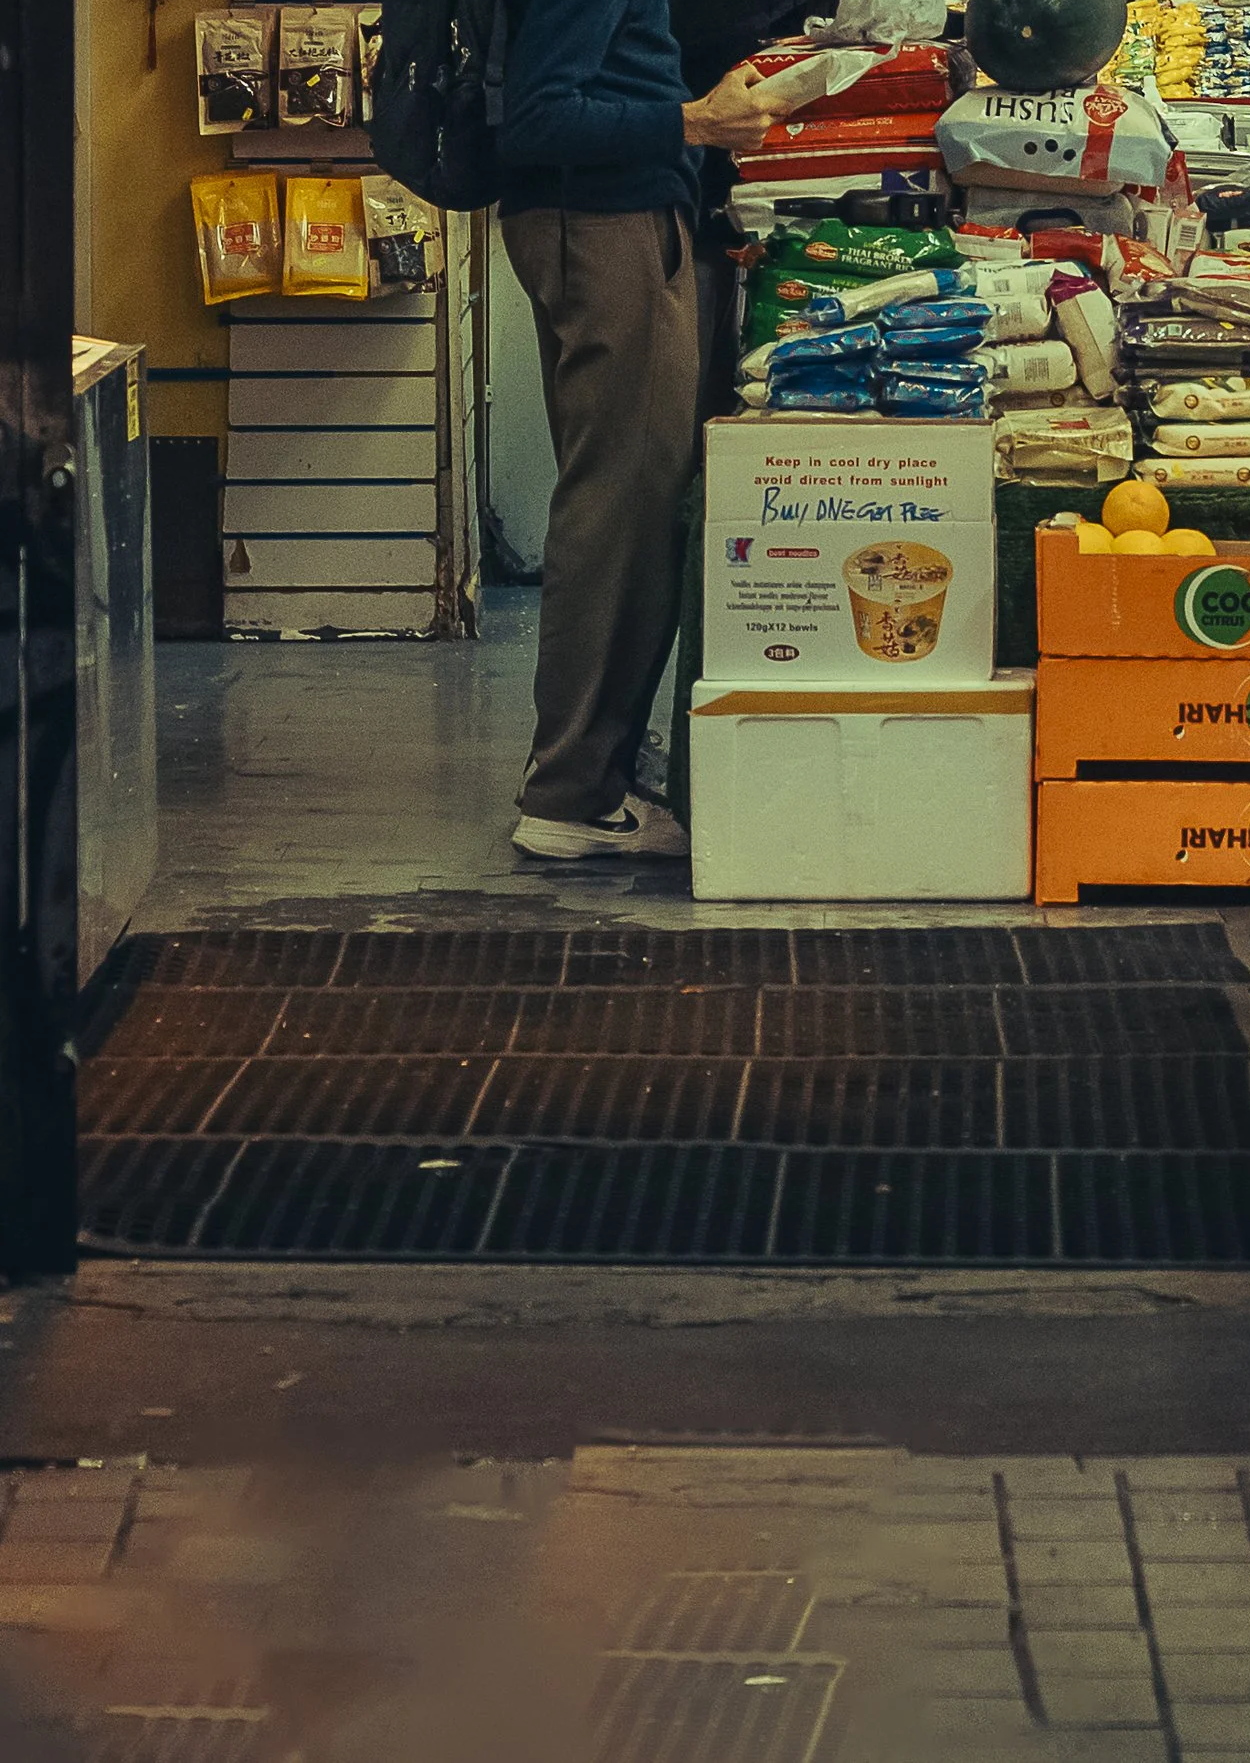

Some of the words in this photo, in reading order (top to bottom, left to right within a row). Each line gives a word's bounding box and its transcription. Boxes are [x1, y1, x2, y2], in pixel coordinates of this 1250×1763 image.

[984, 95, 1075, 124] SUSHI
[841, 255, 892, 269] FRAGRANT
[765, 456, 801, 469] Keep
[808, 456, 822, 468] in
[829, 456, 860, 468] cool
[867, 456, 891, 469] dry
[898, 457, 938, 469] place
[753, 474, 792, 485] avoid
[799, 474, 842, 486] direct
[850, 474, 883, 486] from
[889, 475, 949, 489] sunlight
[746, 622, 786, 633] 120gX12
[788, 622, 819, 632] bowls
[1201, 615, 1246, 627] CITRUS
